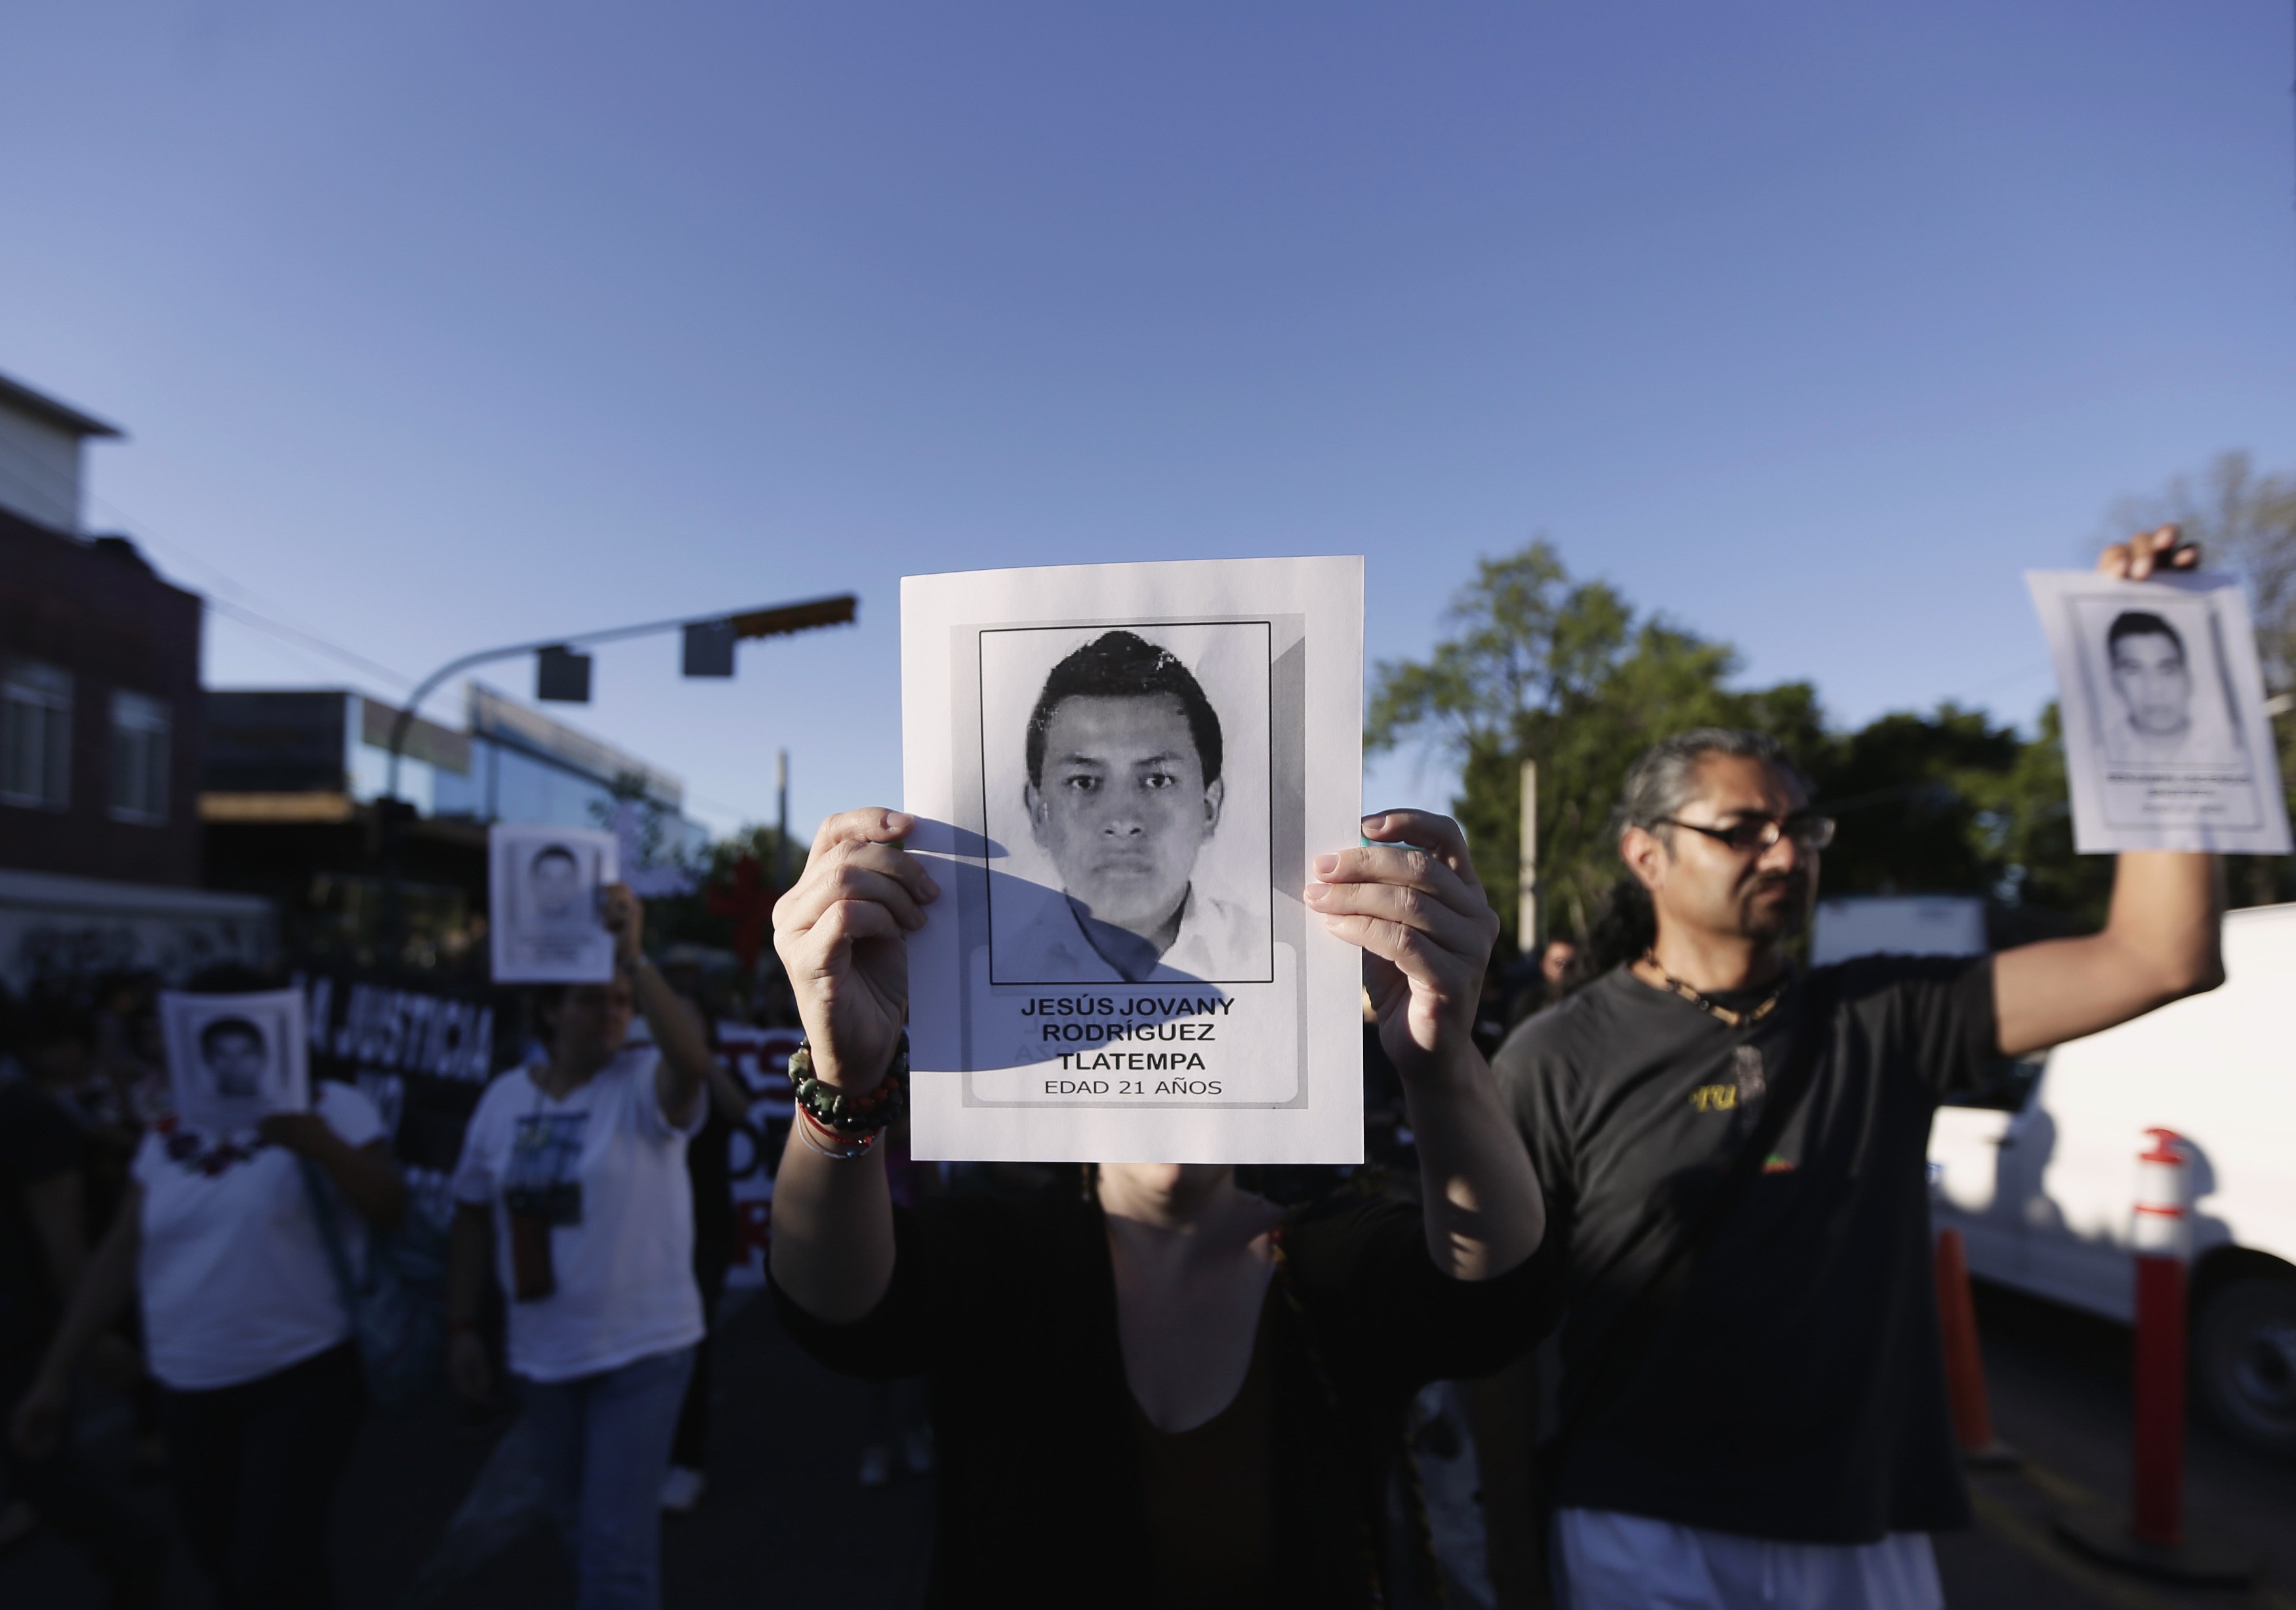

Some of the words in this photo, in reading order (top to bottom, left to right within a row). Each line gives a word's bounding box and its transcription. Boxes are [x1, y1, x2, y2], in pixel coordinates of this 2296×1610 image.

[1021, 992, 1114, 1016] JESÚS
[1119, 997, 1234, 1016] JOVANY
[1042, 1018, 1214, 1041] RODRÍGUEZ
[1056, 1053, 1204, 1070] TLATEMPA
[1045, 1081, 1109, 1093] EDAD
[1119, 1081, 1144, 1094] 21
[1155, 1077, 1221, 1094] AÑOS
